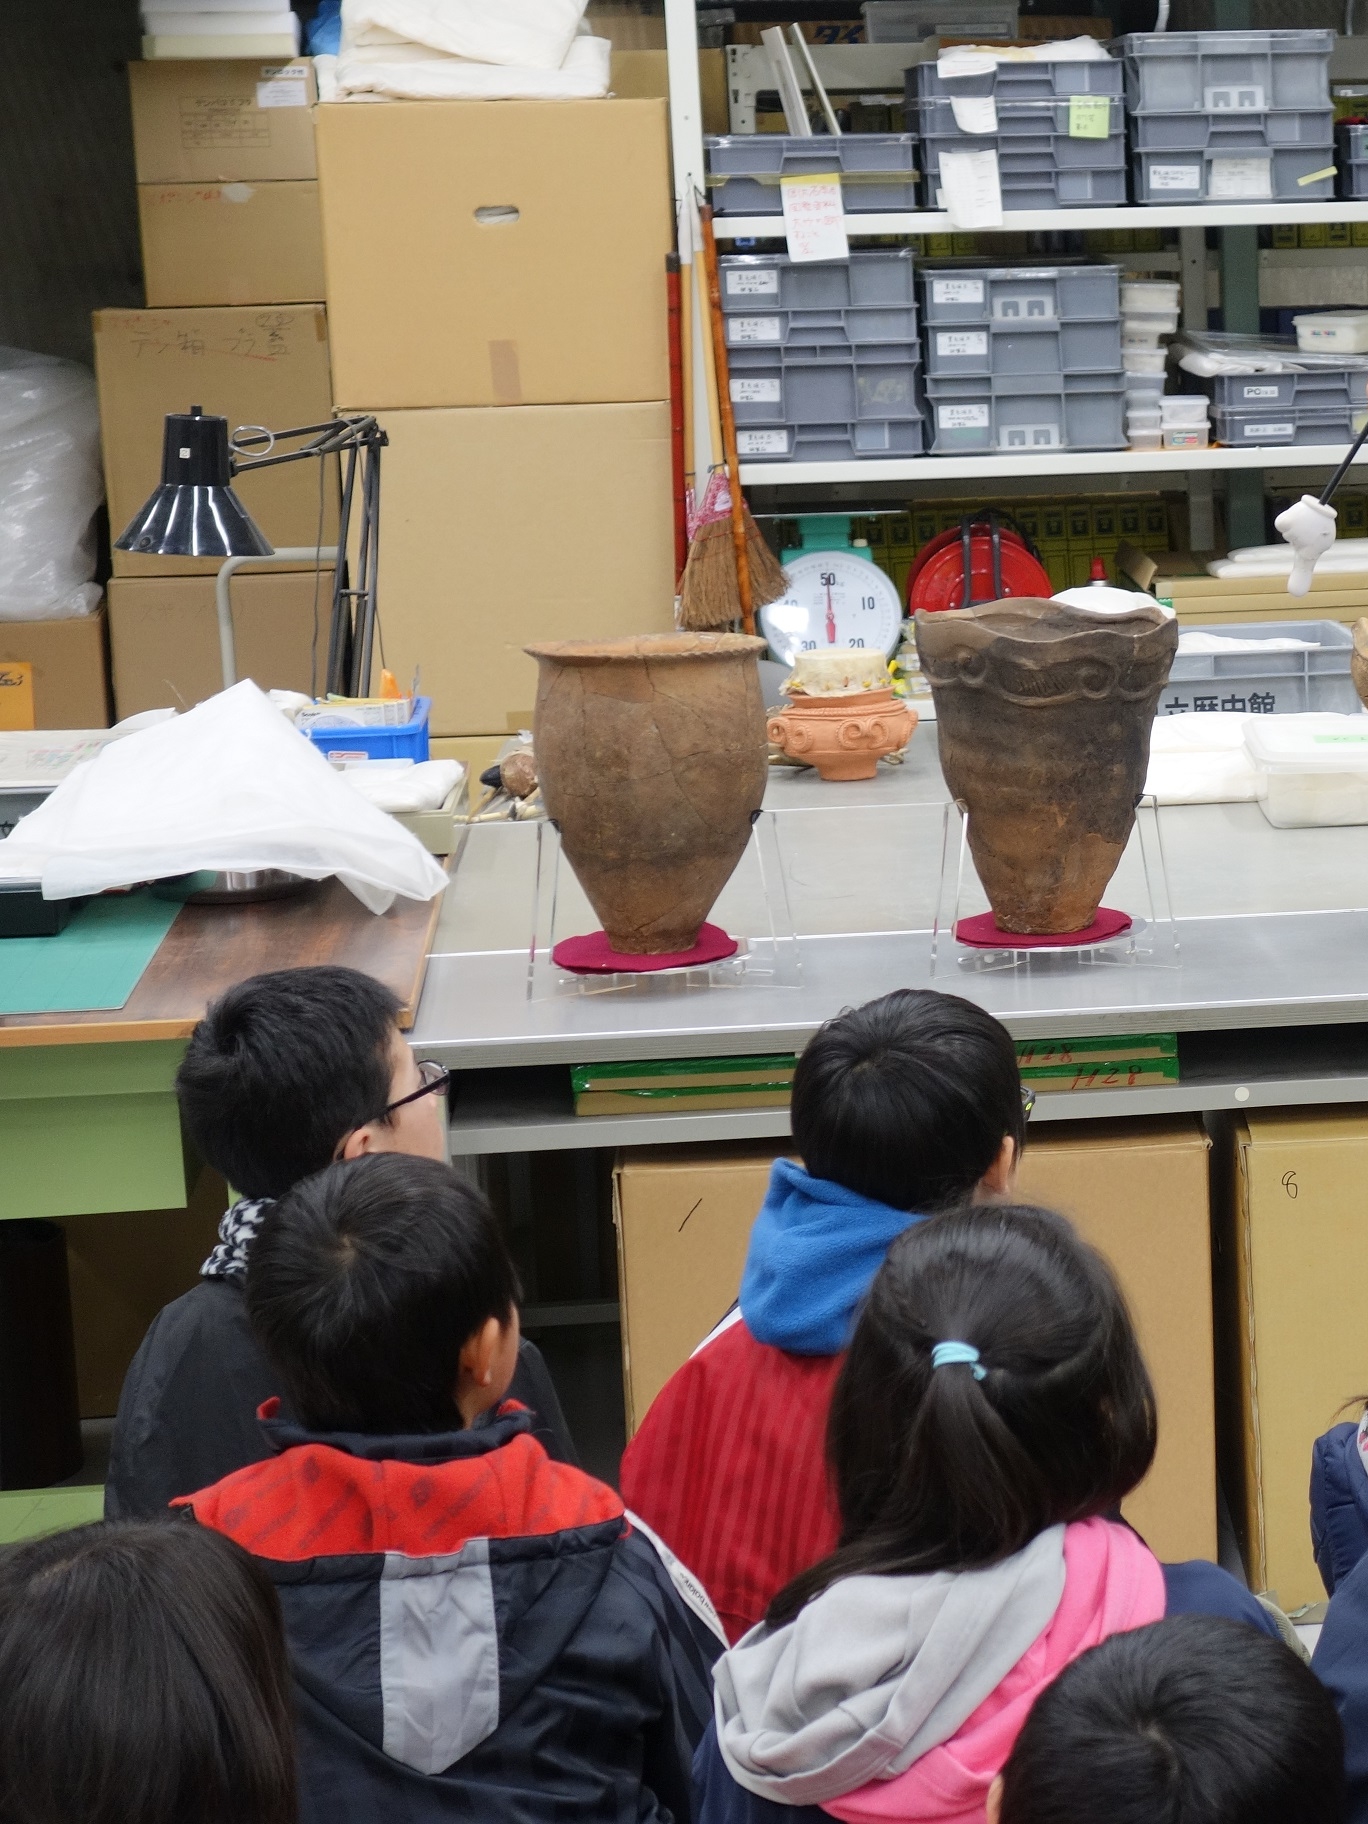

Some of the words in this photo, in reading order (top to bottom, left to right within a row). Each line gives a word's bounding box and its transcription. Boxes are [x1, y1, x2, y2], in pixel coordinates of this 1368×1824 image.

[820, 572, 836, 586] 50
[861, 596, 875, 611] 10
[1071, 1064, 1143, 1090] H28
[1281, 1170, 1298, 1199] 8
